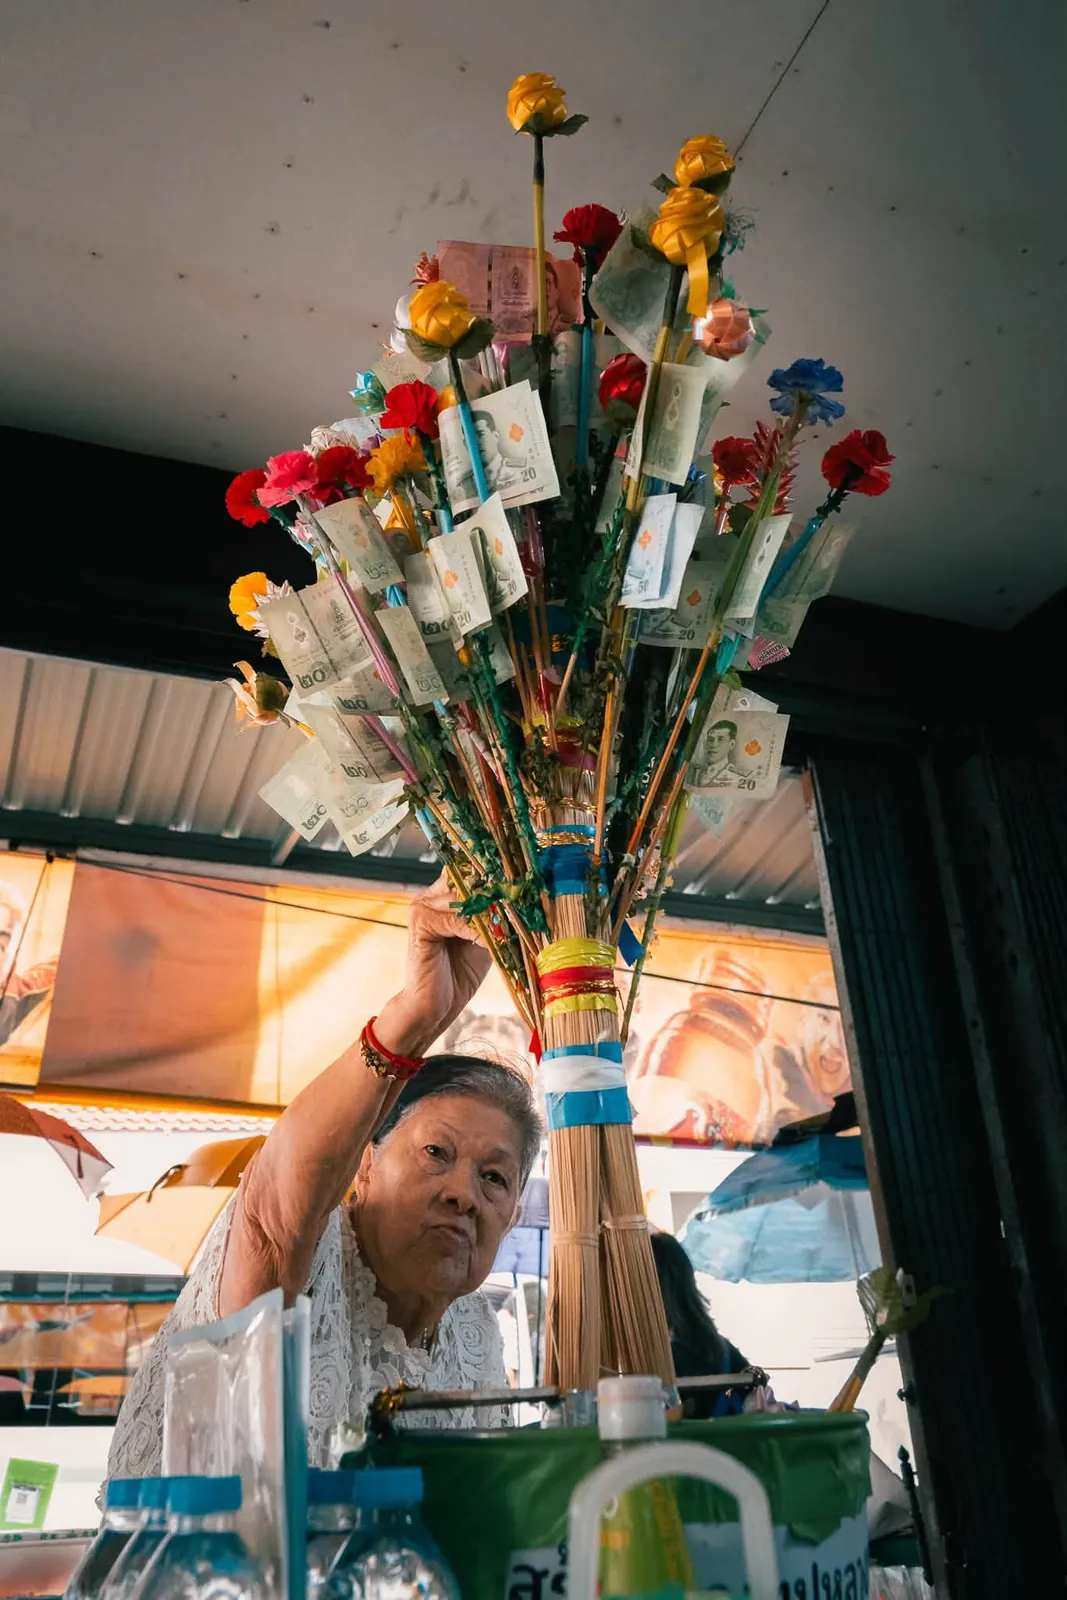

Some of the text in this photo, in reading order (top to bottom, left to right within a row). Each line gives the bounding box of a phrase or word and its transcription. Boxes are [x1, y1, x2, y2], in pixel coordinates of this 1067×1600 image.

[520, 466, 537, 482] 20
[456, 611, 472, 628] 20
[678, 629, 695, 641] 20
[296, 668, 327, 689] ๒๐
[737, 778, 756, 791] 20
